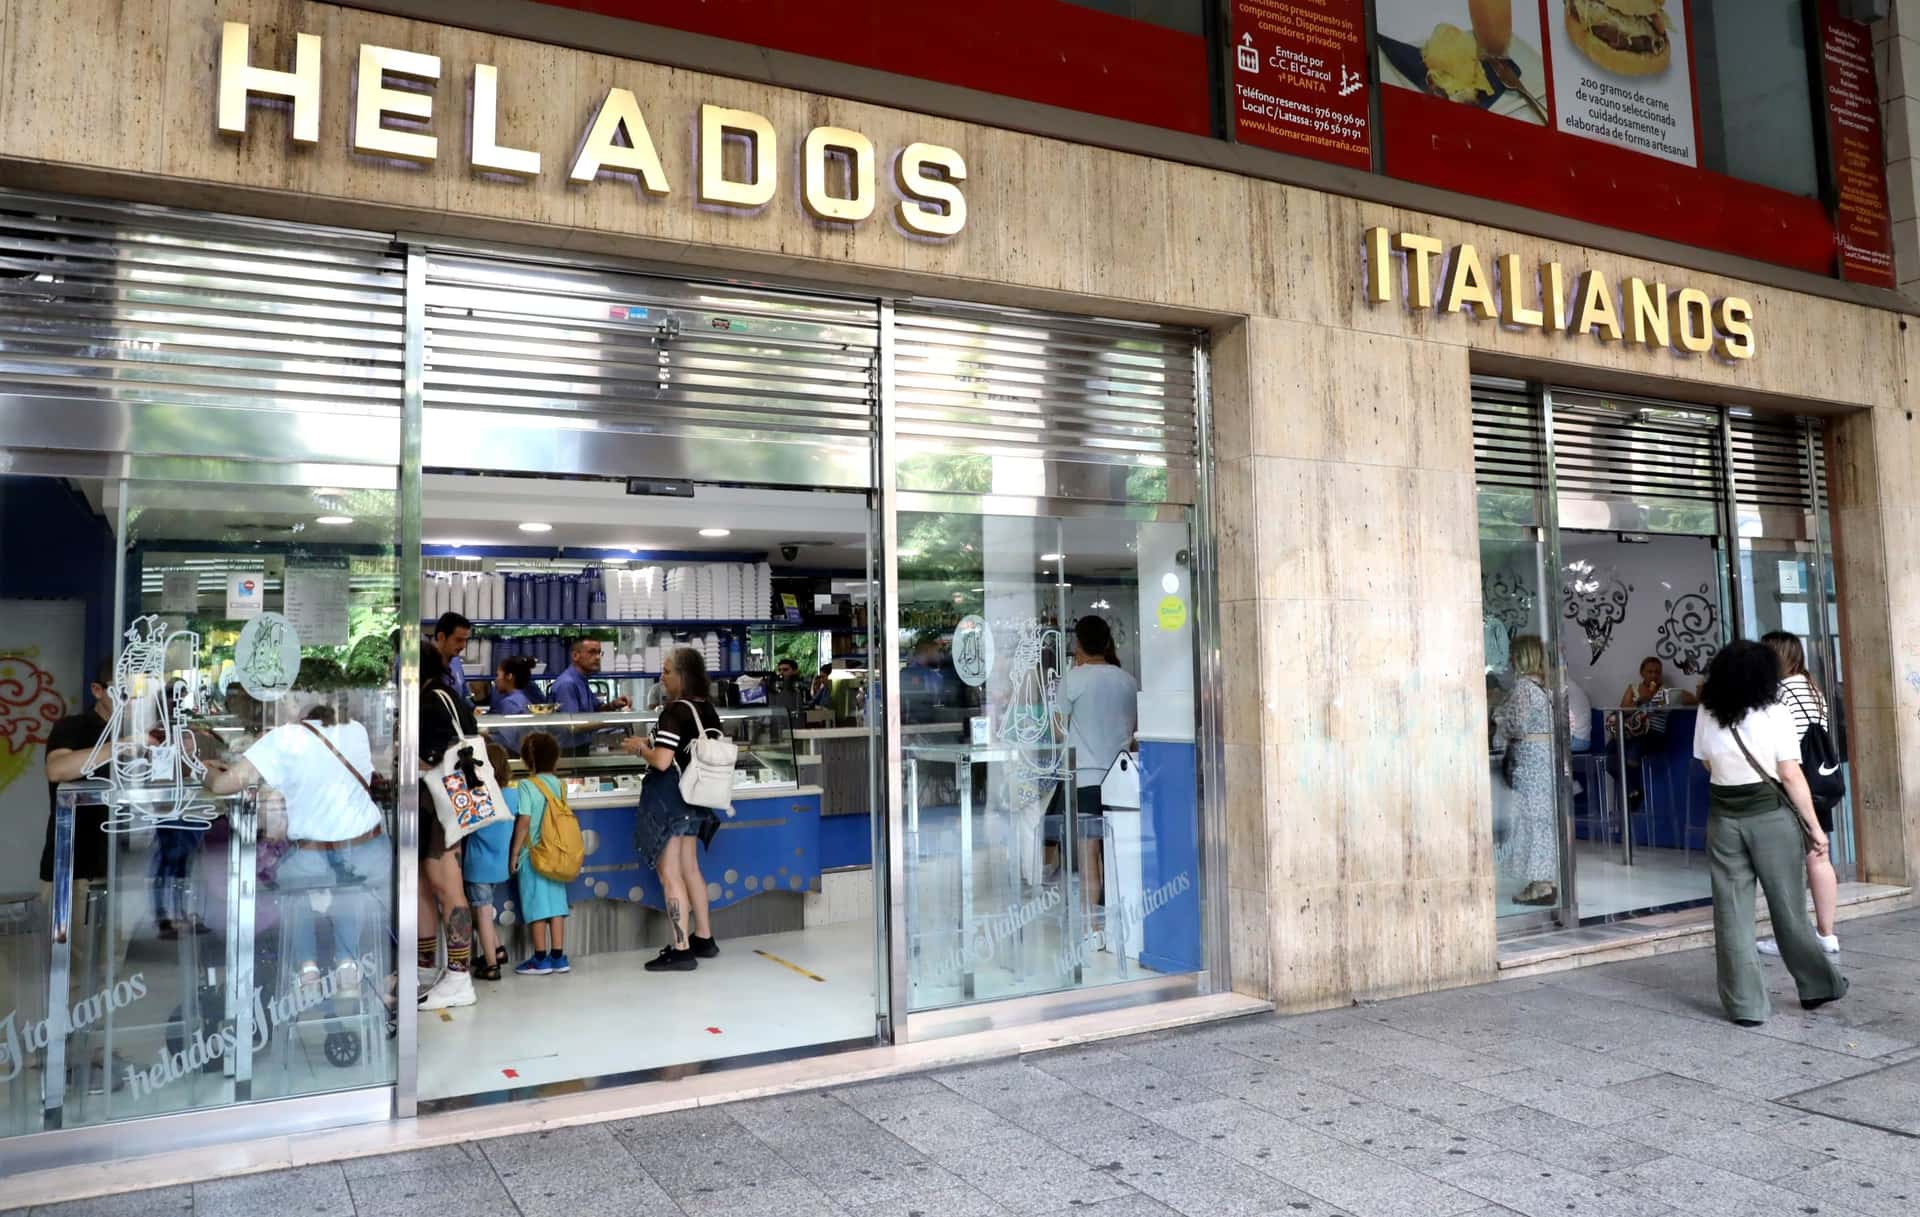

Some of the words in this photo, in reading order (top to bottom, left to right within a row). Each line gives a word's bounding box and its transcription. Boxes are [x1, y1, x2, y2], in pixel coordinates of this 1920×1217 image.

[1239, 3, 1294, 25] compromiso.
[1296, 17, 1346, 40] Disponemos
[1347, 33, 1358, 43] de
[1258, 20, 1305, 41] comedores
[1290, 6, 1340, 25] presupuesto
[1342, 20, 1353, 30] sin
[1269, 56, 1289, 70] C.C.
[1290, 62, 1299, 73] El
[1300, 64, 1331, 81] Caracol
[1276, 46, 1309, 64] Entrada
[1309, 57, 1324, 68] por
[1287, 74, 1327, 93] PLANTA
[1580, 77, 1598, 90] 200
[1600, 82, 1633, 100] gramos
[1633, 90, 1645, 103] de
[1646, 97, 1669, 111] carne
[1236, 83, 1275, 104] Teléfono
[1276, 97, 1314, 113] reservas:
[1315, 108, 1330, 119] 976
[1331, 111, 1342, 122] 09
[1343, 113, 1354, 124] 96
[1355, 117, 1366, 127] 90
[1242, 98, 1265, 114] Local
[1314, 120, 1330, 131] 976
[1331, 124, 1341, 135] 56
[1342, 127, 1351, 138] 91
[1352, 130, 1361, 140] 91
[1575, 89, 1587, 101] de
[1588, 94, 1621, 111] vacuno
[1622, 101, 1676, 127] seleccionada
[1588, 108, 1660, 136] cuidadosamente
[1660, 128, 1666, 141] y
[217, 22, 968, 237] HELADOS
[1240, 118, 1370, 154] www.lacomarcamatarraña.com
[1566, 115, 1611, 137] elaborada
[1612, 128, 1623, 141] de
[1624, 131, 1650, 148] forma
[1652, 139, 1689, 158] artesanal
[1366, 226, 1754, 360] ITALIANOS
[1114, 871, 1191, 946] Itlianos
[0, 972, 147, 1083] Itaianos
[122, 1024, 238, 1102] helados
[250, 951, 378, 1053] Italins
